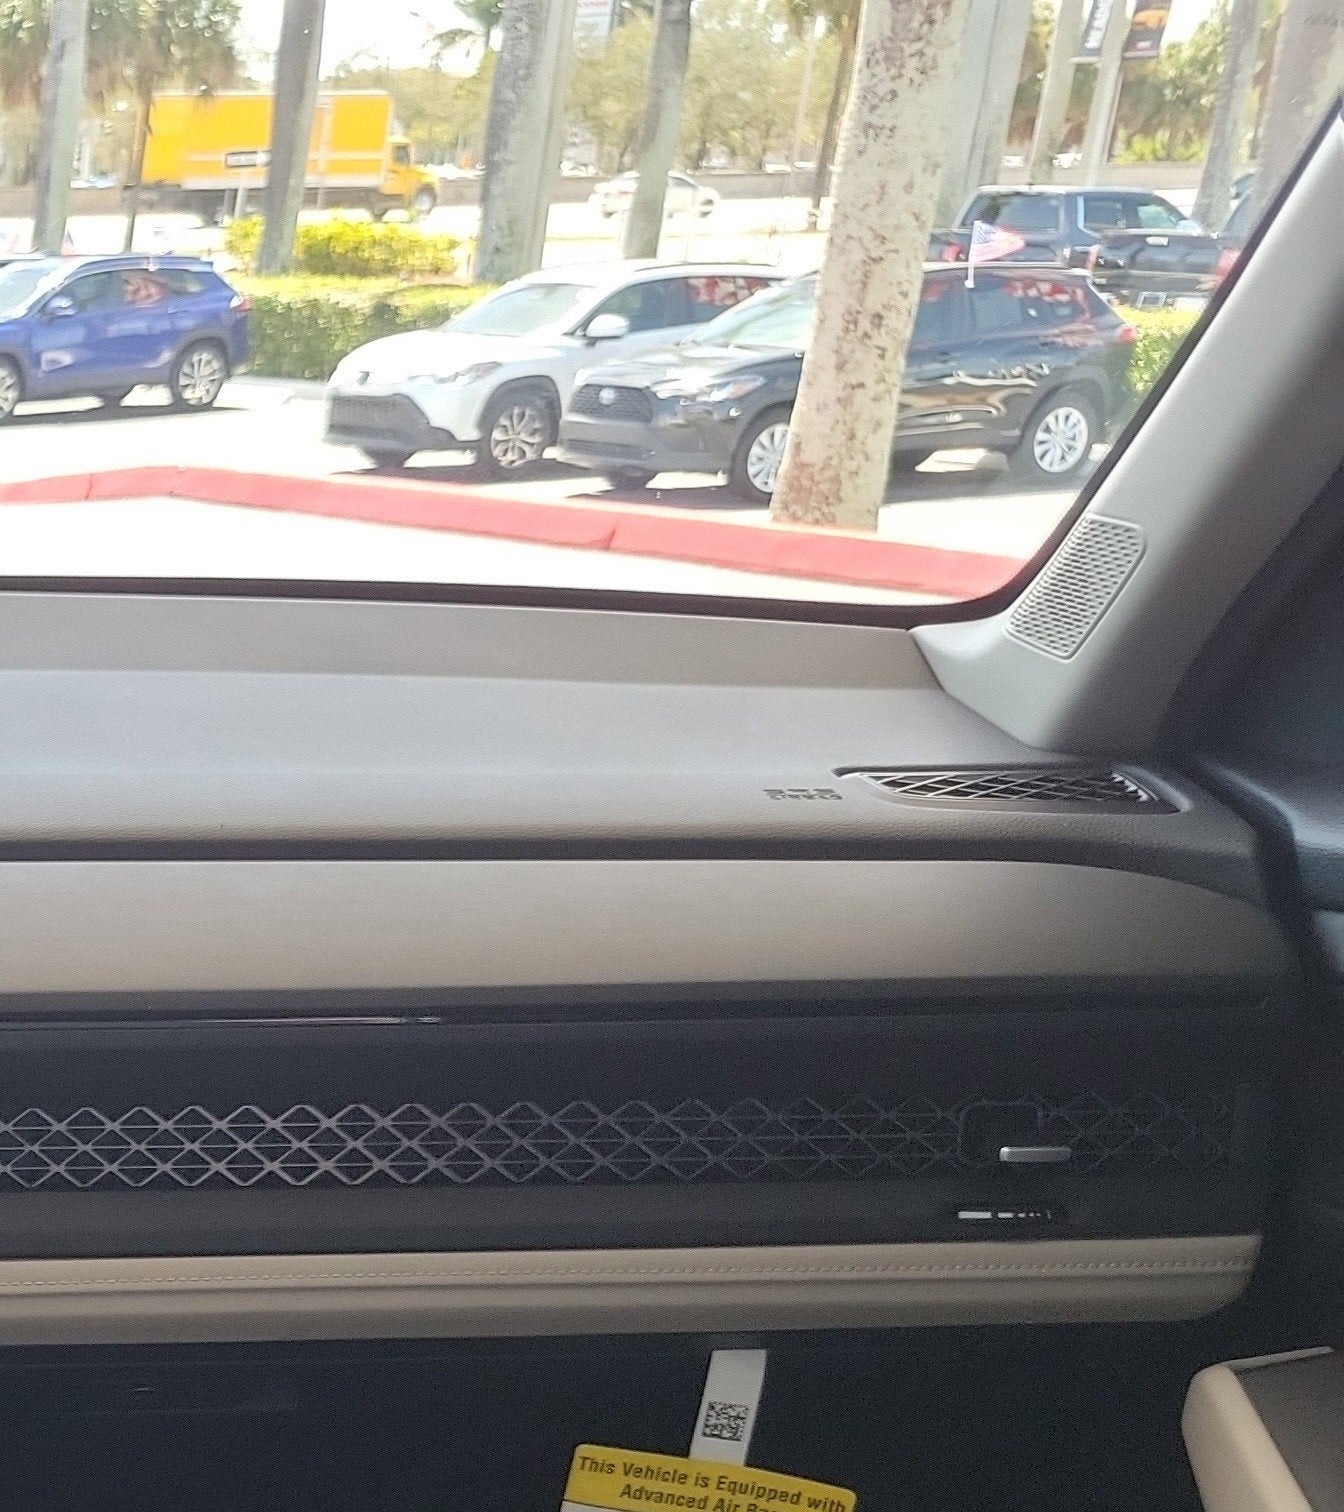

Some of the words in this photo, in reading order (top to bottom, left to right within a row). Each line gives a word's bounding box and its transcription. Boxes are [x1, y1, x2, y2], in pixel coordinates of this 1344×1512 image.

[578, 1455, 615, 1475] This
[621, 1461, 686, 1486] Vehicle
[694, 1473, 709, 1488] is
[715, 1475, 801, 1507] Equipped
[621, 1481, 706, 1511] Advanced
